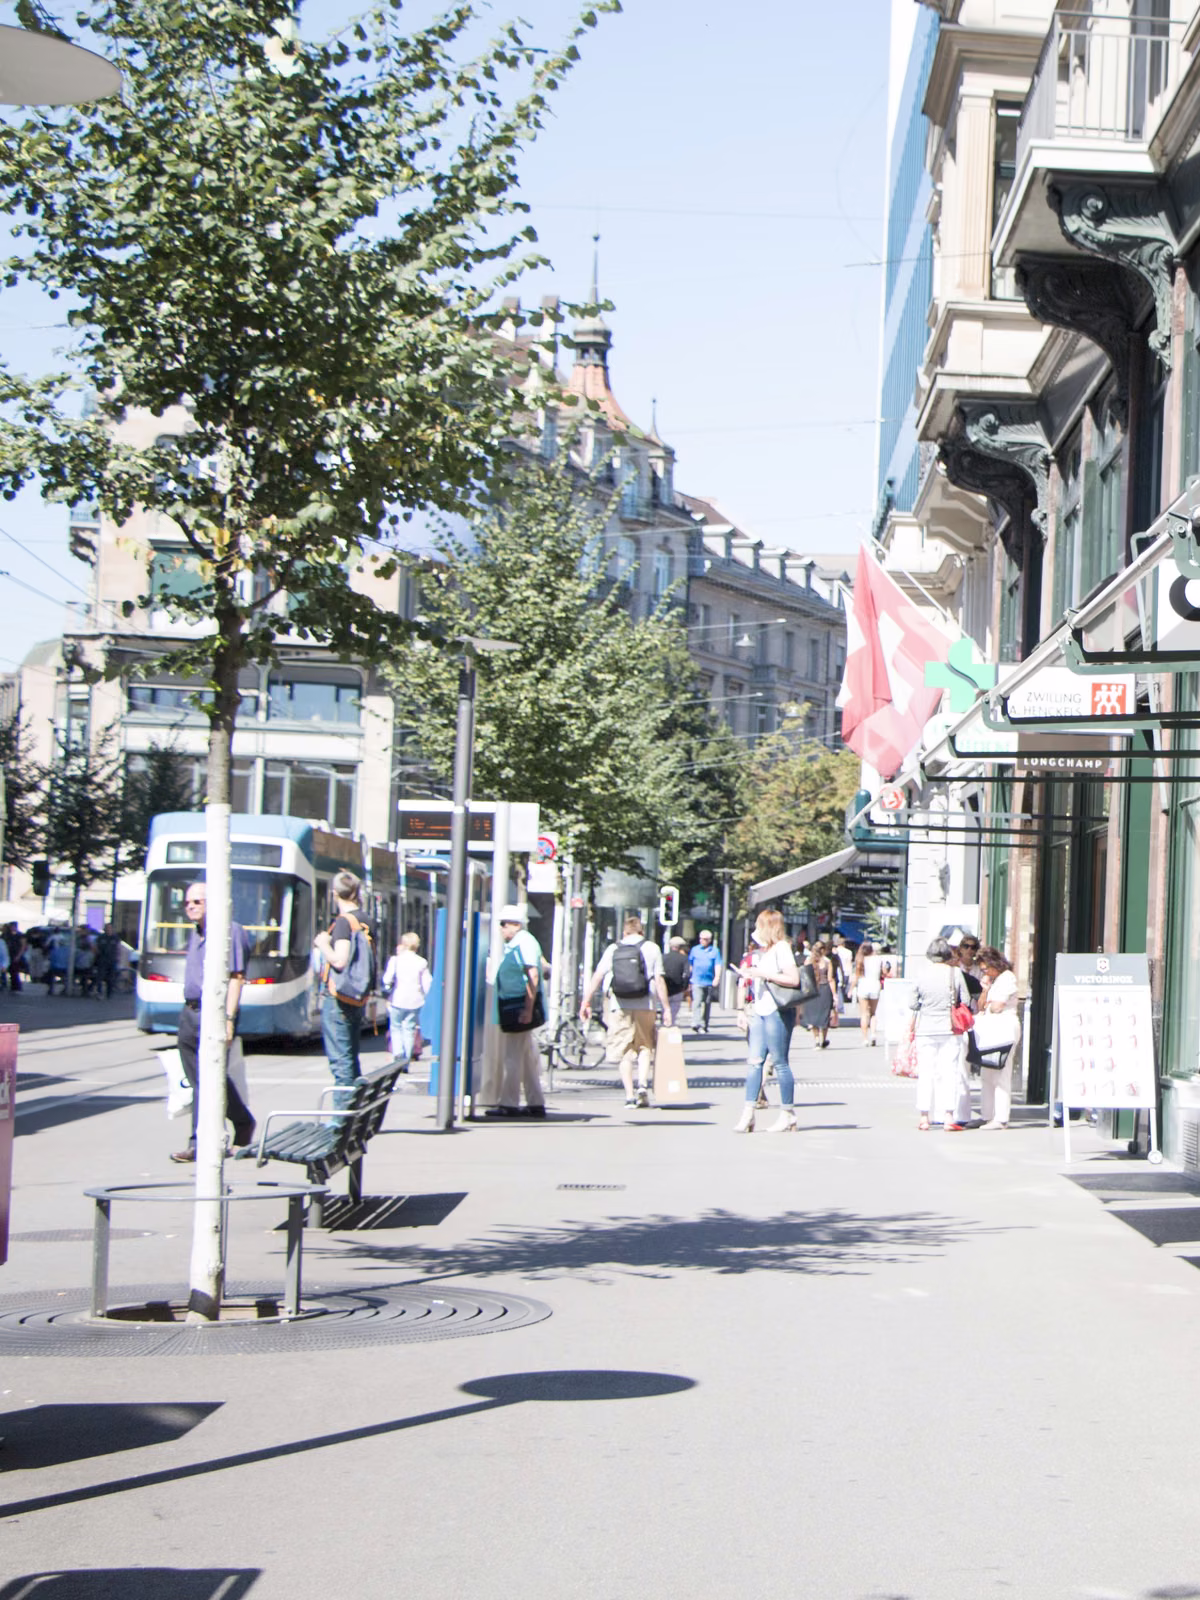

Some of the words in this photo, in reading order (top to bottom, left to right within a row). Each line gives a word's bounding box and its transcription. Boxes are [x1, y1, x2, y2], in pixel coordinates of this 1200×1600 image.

[1026, 692, 1082, 704] ZWILLING
[1024, 705, 1082, 716] HENCKELS
[1023, 757, 1103, 768] LONGCHAMP
[1073, 975, 1134, 984] VICTORINOX
